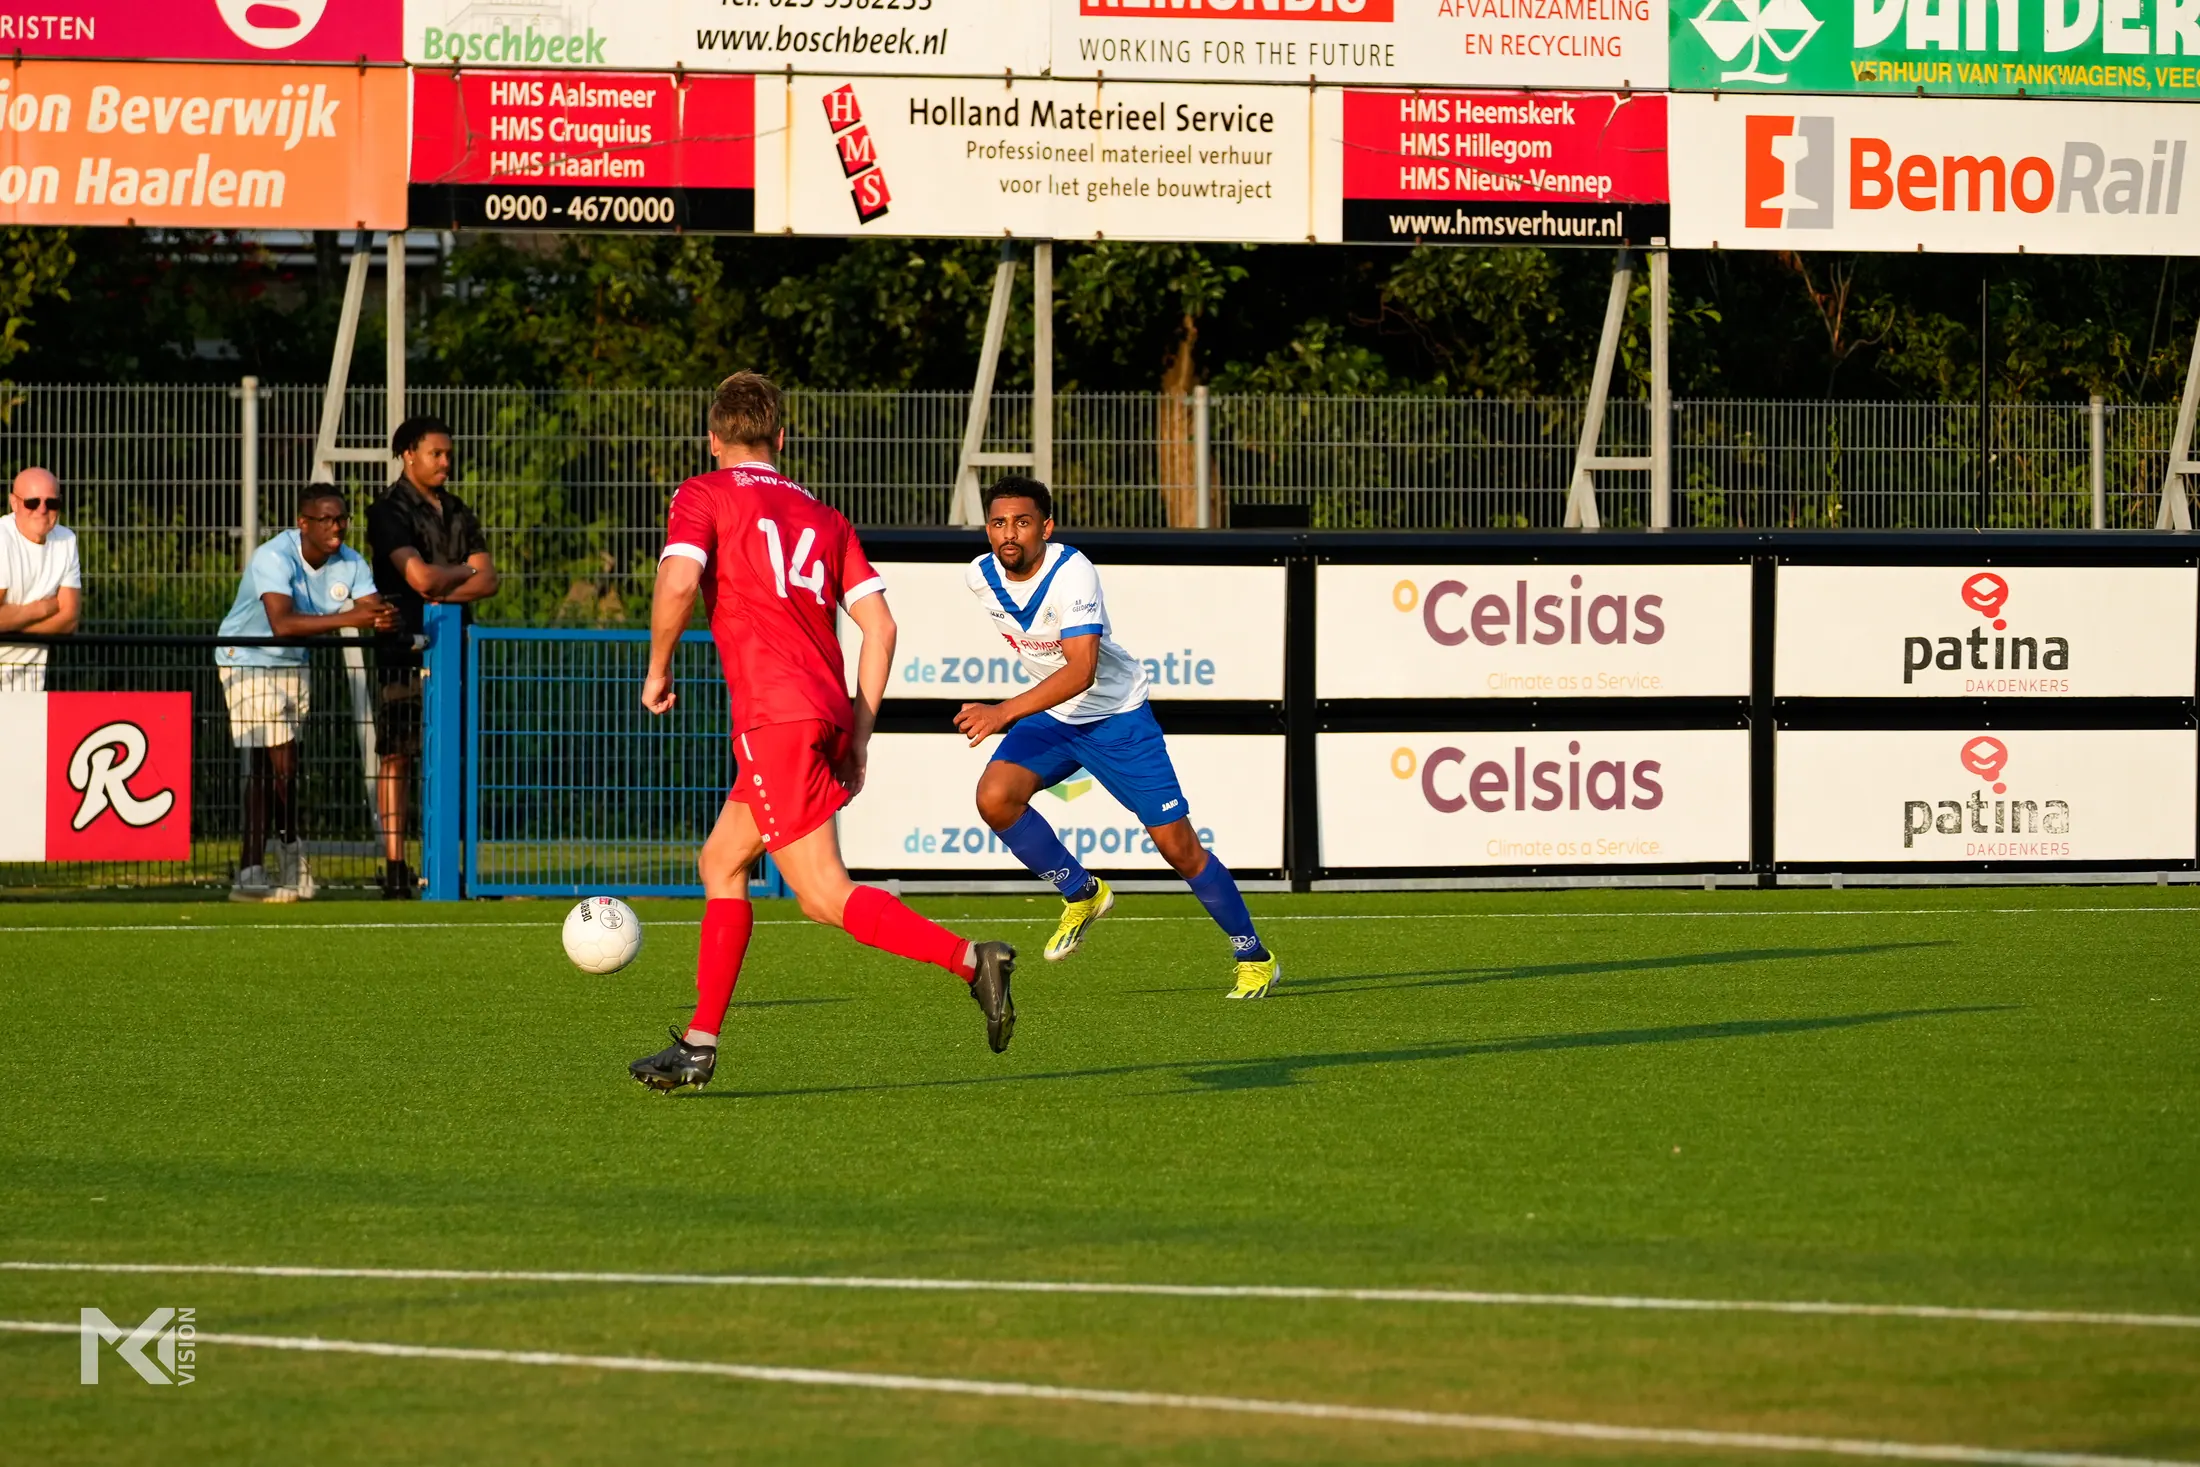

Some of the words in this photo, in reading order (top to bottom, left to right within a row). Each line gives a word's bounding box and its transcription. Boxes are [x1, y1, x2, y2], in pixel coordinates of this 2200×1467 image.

[1438, 0, 1650, 21] AFVALINZAMELING
[0, 15, 95, 40] RISTEN
[697, 25, 948, 55] www.boschbeek.nl
[424, 26, 607, 63] Boschbeek
[1079, 38, 1191, 63] WORKING
[1204, 40, 1245, 64] FOR
[1255, 41, 1297, 65] THE
[1309, 42, 1395, 67] FUTURE
[1465, 33, 1493, 55] EN
[1501, 34, 1622, 57] RECYCLING
[1851, 61, 1952, 83] VERHUUR
[1957, 63, 1999, 84] VAN
[2002, 64, 2152, 91] TANKWAGENS,
[491, 81, 544, 107] HMS
[549, 82, 656, 109] Aalsmeer
[87, 84, 340, 151] Beverwijk
[910, 98, 1019, 126] Holland
[1030, 100, 1165, 131] Materieel
[1176, 103, 1274, 133] Service
[1400, 99, 1450, 123] HMS
[1455, 101, 1576, 125] Heemskerk
[491, 117, 544, 142] HMS
[550, 118, 652, 148] Cruquius
[967, 140, 1094, 163] Professioneel
[1102, 144, 1191, 164] materieel
[1199, 145, 1273, 165] verhuur
[1400, 133, 1450, 157] HMS
[1455, 134, 1552, 164] Hillegom
[491, 151, 544, 177] HMS
[551, 153, 645, 178] Haarlem
[1850, 137, 2187, 214] BemoRail
[75, 153, 286, 208] Haarlem
[1000, 178, 1042, 194] voor
[1087, 177, 1150, 202] gehele
[1157, 178, 1272, 204] bouwtraject
[1400, 167, 1450, 190] HMS
[1455, 168, 1612, 198] Nieuw-Vennep
[485, 194, 547, 221] 0900
[567, 196, 675, 223] 4670000
[1389, 209, 1623, 237] www.hmsverhuur.nl
[757, 517, 826, 605] 14
[1903, 626, 2069, 684] patina
[1487, 673, 1553, 690] Climate
[1558, 676, 1578, 690] as
[1582, 676, 1593, 690] a
[1598, 672, 1664, 690] Service.
[1966, 679, 2069, 692] DAKDENKERS
[1161, 798, 1178, 812] JAKO
[1904, 790, 2070, 848] patina
[1486, 840, 1552, 856] Climate
[1557, 843, 1577, 856] as
[1581, 842, 1592, 856] a
[1966, 843, 2070, 856] DAKDENKERS
